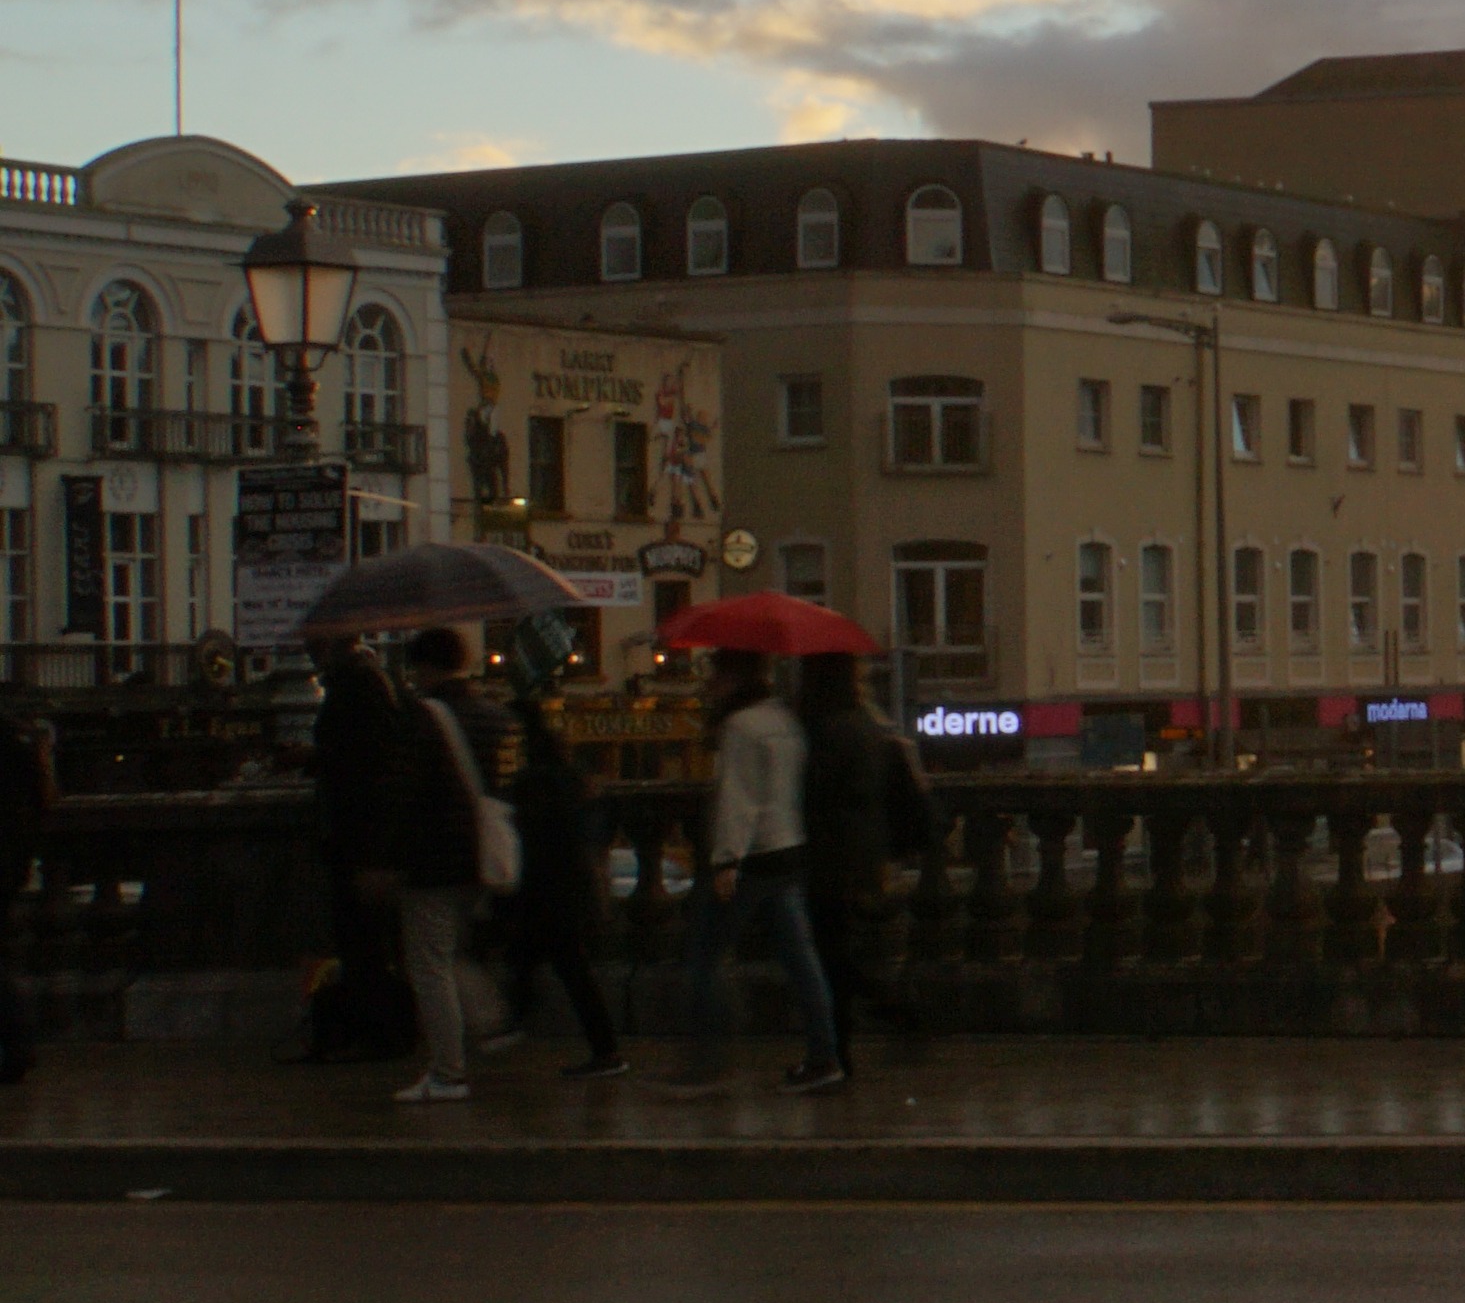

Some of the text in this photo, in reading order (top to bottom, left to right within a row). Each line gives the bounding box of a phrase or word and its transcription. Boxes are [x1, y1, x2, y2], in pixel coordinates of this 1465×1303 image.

[560, 349, 615, 374] LARRY
[532, 370, 646, 405] TOMPKINS
[916, 706, 1019, 736] derne
[1366, 698, 1428, 722] moderne
